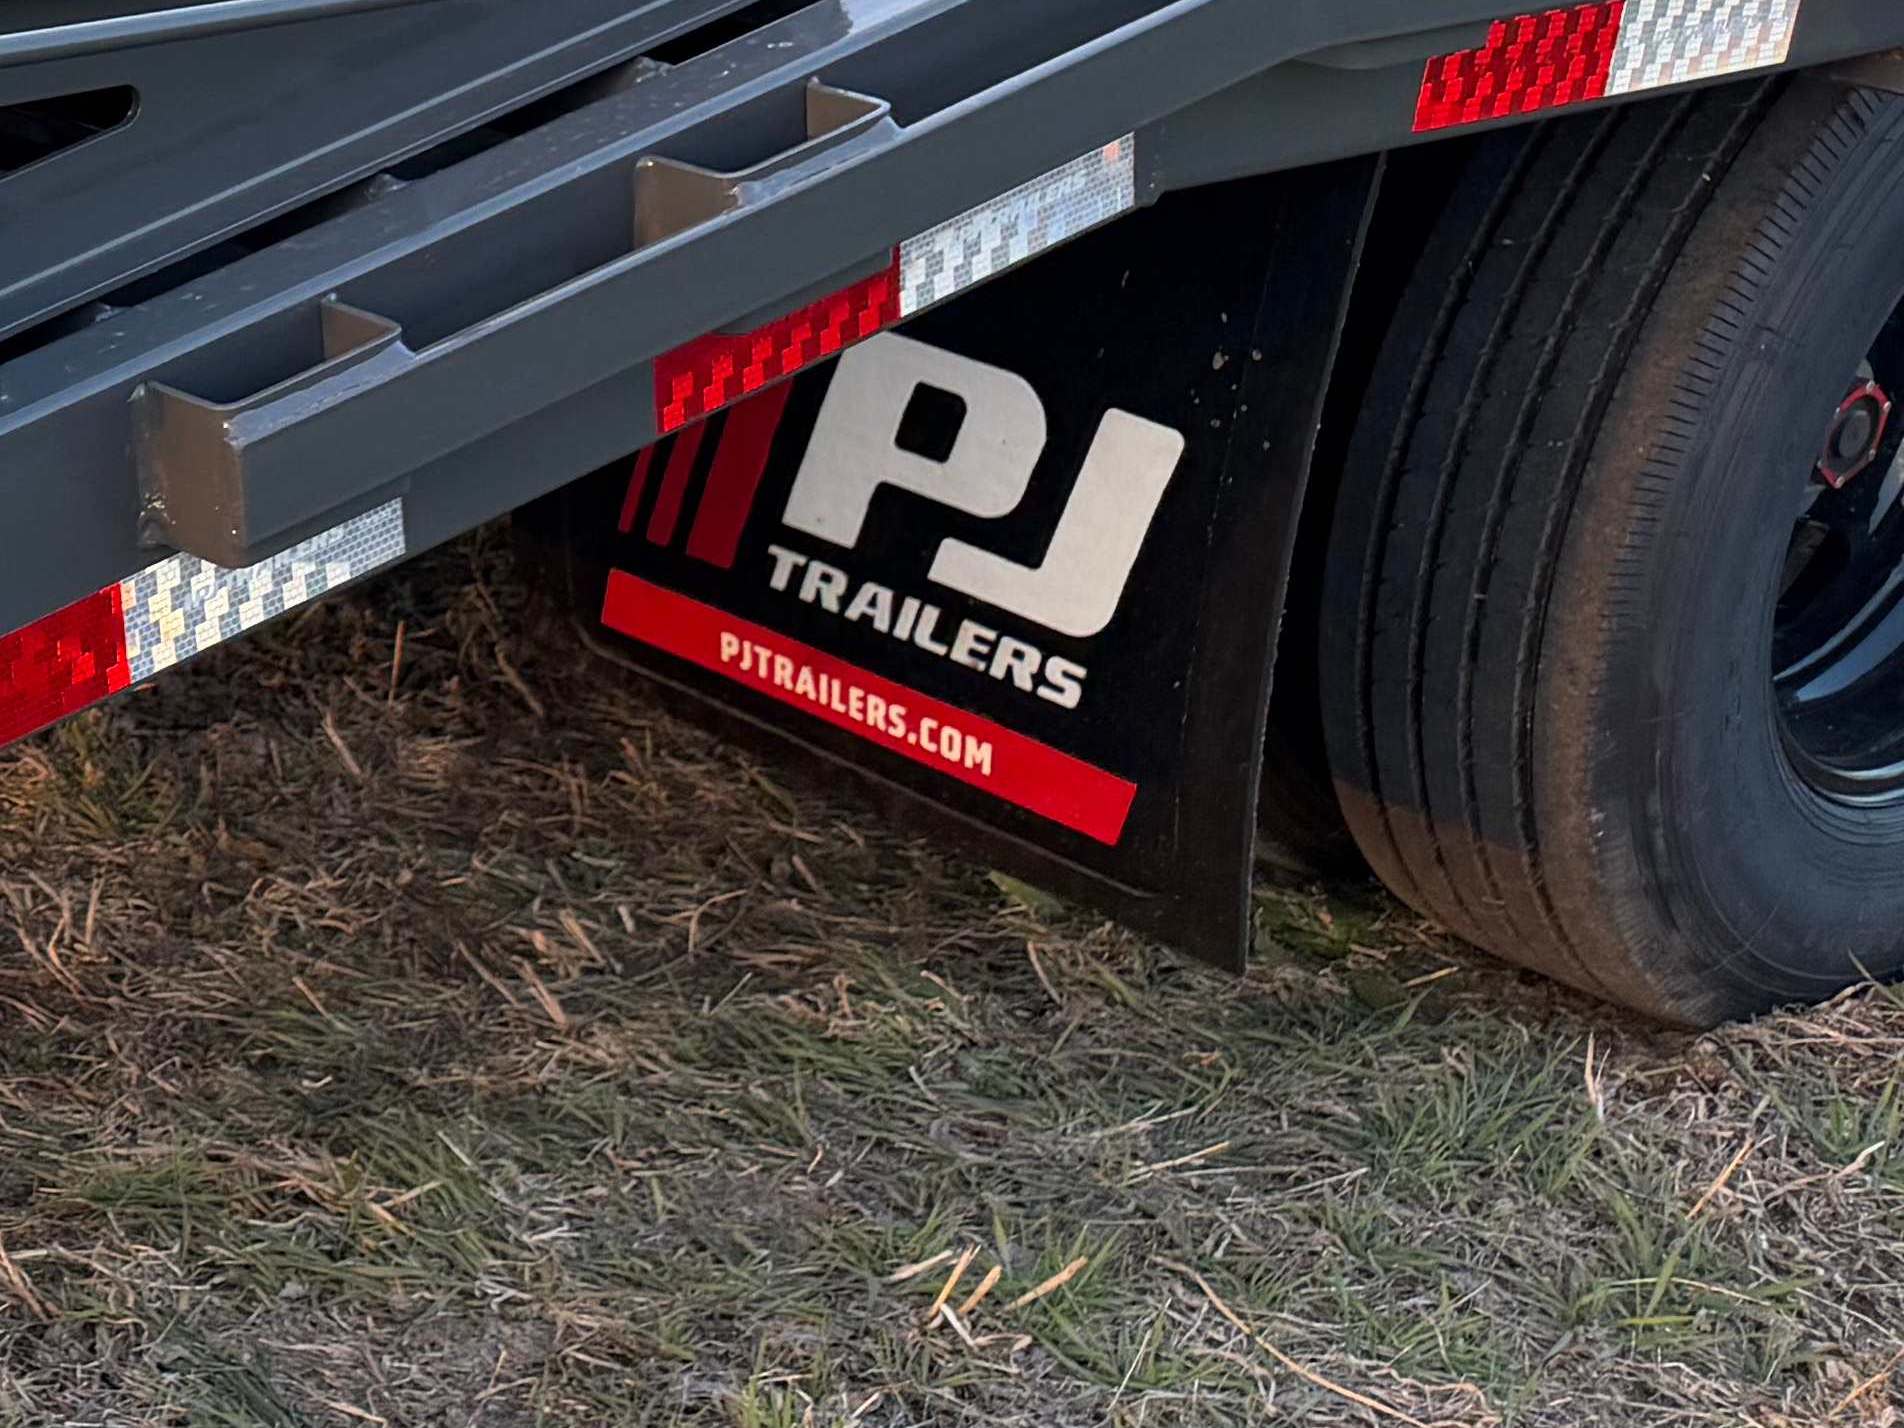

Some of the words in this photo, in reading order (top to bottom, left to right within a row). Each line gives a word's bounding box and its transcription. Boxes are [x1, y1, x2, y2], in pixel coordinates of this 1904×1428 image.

[782, 332, 1185, 638] PJ
[719, 630, 993, 777] PJTRAILERS.COM
[767, 544, 1088, 710] TRAILERS
